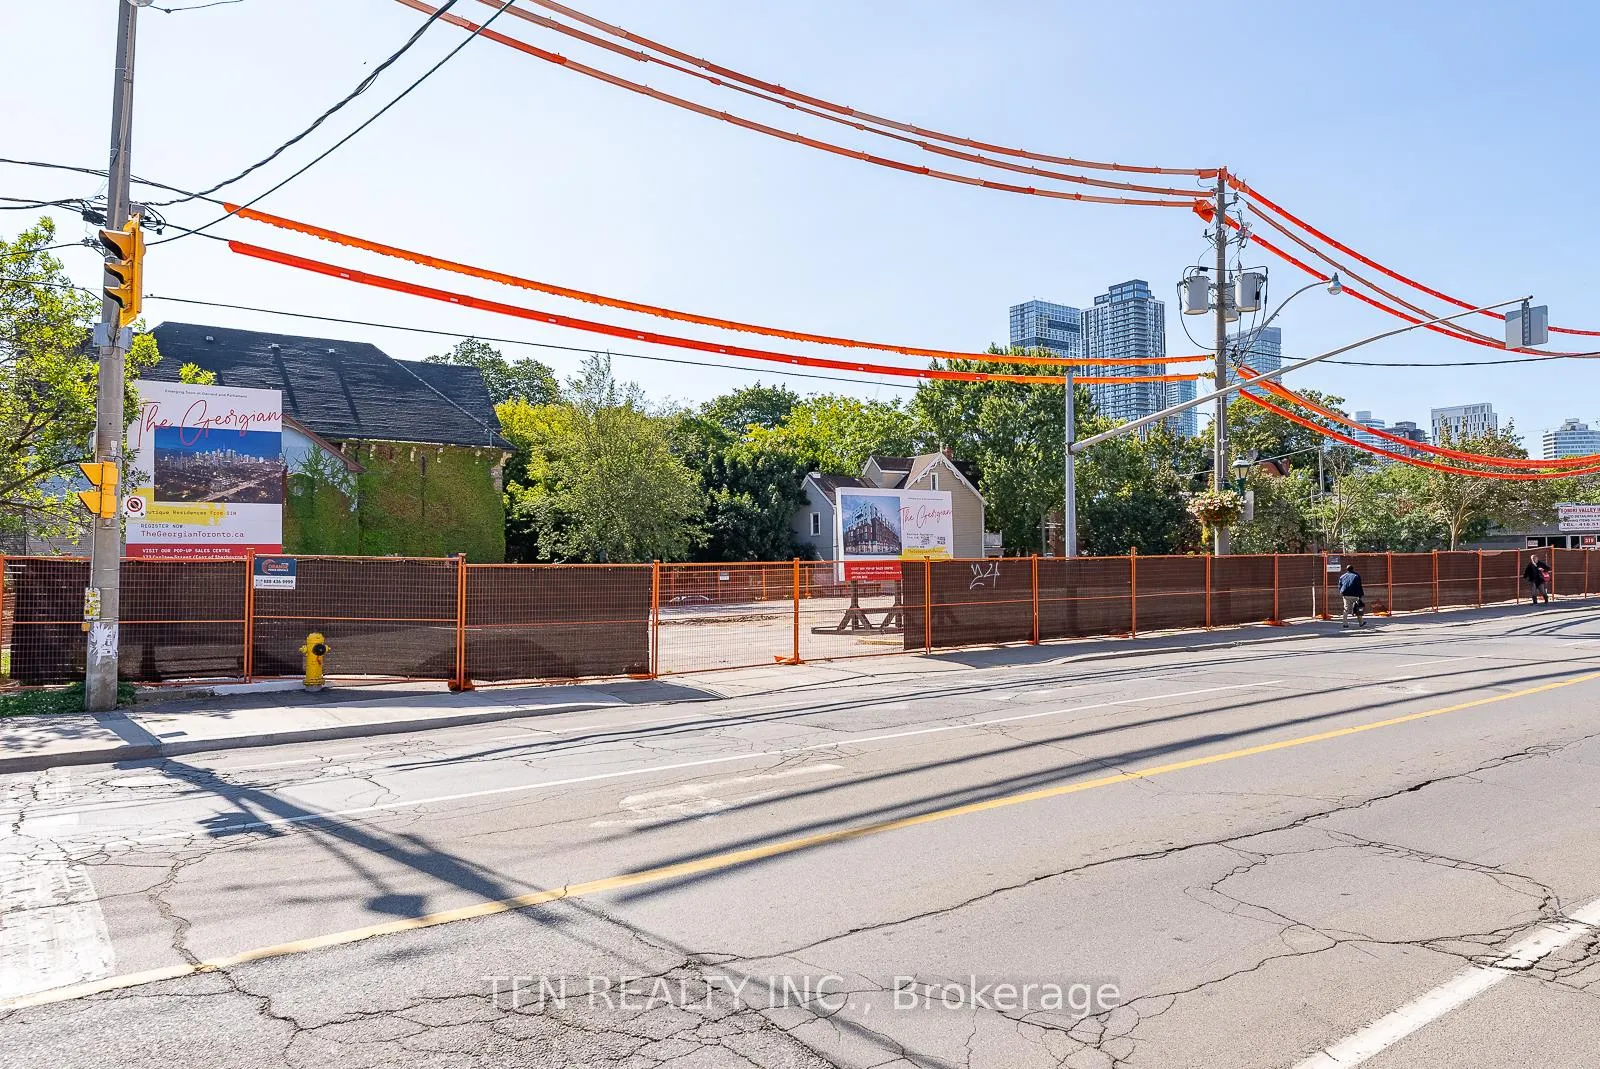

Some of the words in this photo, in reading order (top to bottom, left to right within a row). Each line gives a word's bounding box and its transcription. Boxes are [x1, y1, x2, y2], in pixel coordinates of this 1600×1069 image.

[138, 401, 173, 449] The
[179, 399, 284, 447] Georgian
[141, 530, 245, 539] TheGeorgianToronto.ca
